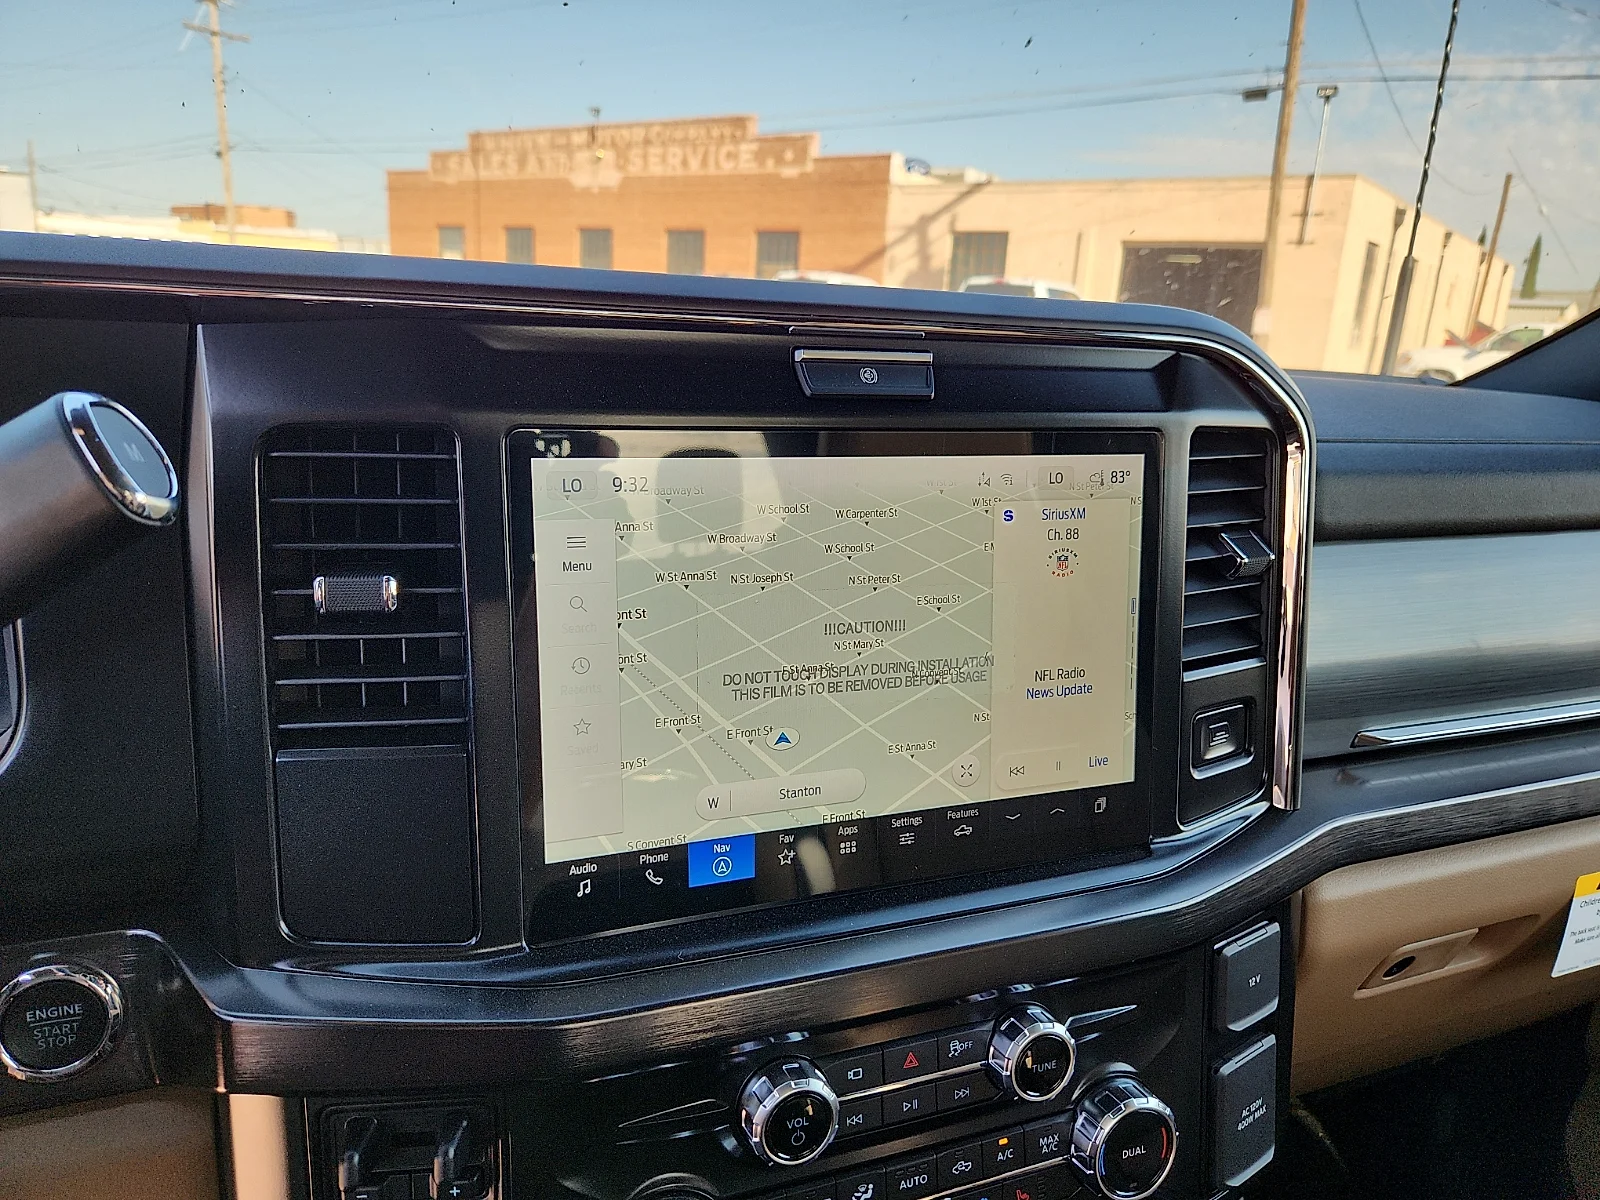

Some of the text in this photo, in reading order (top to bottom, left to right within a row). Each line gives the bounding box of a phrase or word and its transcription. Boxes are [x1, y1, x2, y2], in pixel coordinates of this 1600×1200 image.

[628, 142, 760, 172] SERVICE
[612, 476, 649, 493] 9:32
[1049, 472, 1064, 485] LO
[562, 478, 582, 493] LO
[694, 485, 705, 495] St
[971, 497, 981, 507] W
[982, 497, 992, 507] 1st
[1130, 497, 1137, 505] N
[757, 504, 810, 514] W School St
[835, 508, 898, 520] W Carpenter St
[1041, 507, 1087, 520] SiriusXM
[615, 521, 654, 532] Anna St
[707, 533, 777, 545] W Broadway St
[1047, 528, 1080, 541] Ch. 88
[824, 543, 875, 554] W School St
[562, 562, 592, 572] Menu
[655, 571, 717, 583] W St Anna St
[730, 573, 794, 586] N St Joseph St
[849, 574, 901, 585] N St Peter St
[1051, 570, 1074, 578] RADIO
[917, 595, 961, 606] E School St
[635, 608, 647, 619] St
[824, 620, 906, 636] !!!CAUTION!!!
[834, 639, 884, 651] N St Mary St
[636, 652, 648, 663] St
[723, 655, 994, 686] DO NOT TOUCH DISPLAY DURING INSTALLATION
[1034, 667, 1086, 682] NFL Radio
[732, 670, 987, 701] THIS FILM IS TO BE REMOVED BEFORE USAGE
[1026, 684, 1093, 700] News Update
[655, 714, 701, 728] E Front St
[973, 712, 990, 722] N St
[727, 730, 733, 739] E
[735, 728, 762, 738] Front
[888, 740, 936, 754] E St Anna St
[636, 757, 647, 768] St
[1088, 755, 1109, 768] Live
[708, 785, 822, 809] W Stanton
[830, 811, 854, 823] Front
[856, 810, 866, 820] St
[947, 808, 979, 820] Features
[891, 815, 923, 828] Settings
[838, 824, 858, 835] Apps
[627, 834, 687, 851] S Convent St
[779, 834, 794, 845] Fav
[713, 843, 731, 854] Nav
[639, 852, 669, 865] Phone
[569, 863, 598, 876] Audio
[26, 1003, 83, 1022] ENGINE
[33, 1022, 80, 1039] START
[38, 1034, 77, 1050] STOP
[959, 1041, 973, 1050] OFF
[1032, 1060, 1057, 1073] TUNE
[787, 1117, 809, 1130] VOL
[1039, 1133, 1060, 1147] MAX
[1041, 1142, 1058, 1155] A/C
[1122, 1145, 1147, 1160] DUAL
[997, 1149, 1014, 1162] A/C
[900, 1174, 929, 1191] AUTO
